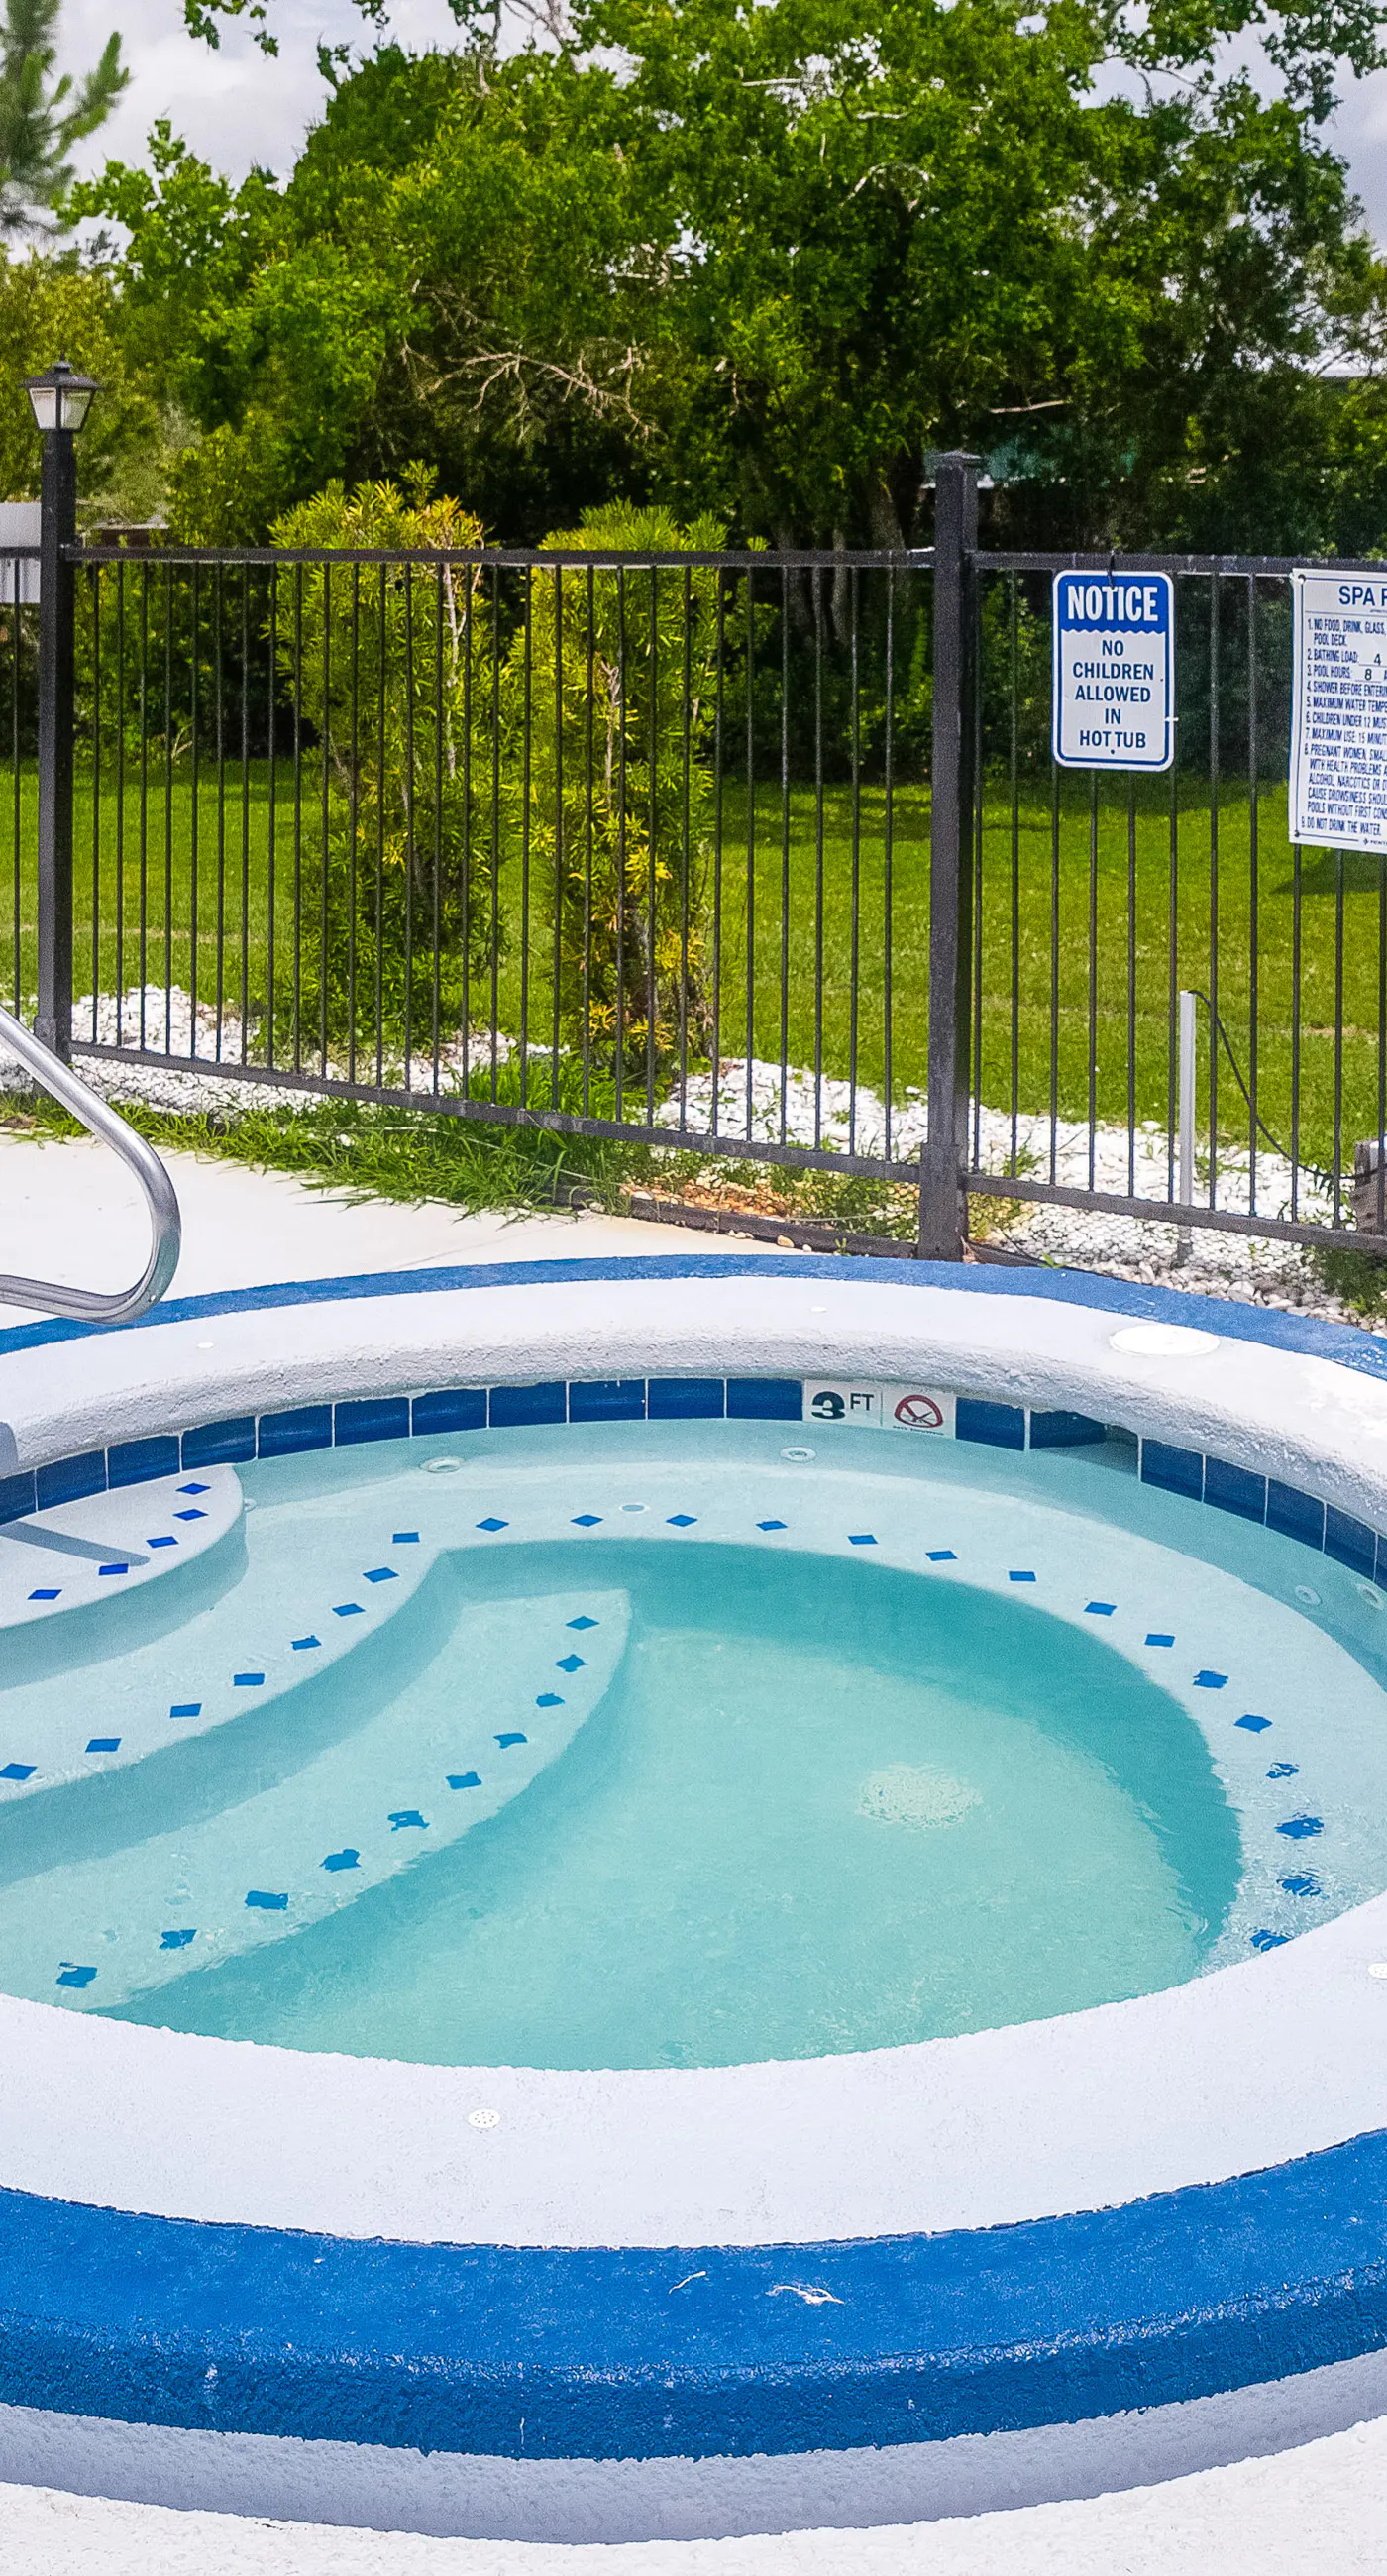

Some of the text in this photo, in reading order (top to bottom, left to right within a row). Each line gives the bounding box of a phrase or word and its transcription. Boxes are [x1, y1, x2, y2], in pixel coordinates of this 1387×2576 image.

[1067, 585, 1159, 621] NOTICE
[1338, 585, 1376, 606] SPA
[1314, 618, 1323, 630] NO
[1314, 633, 1329, 645] POOL
[1102, 640, 1123, 656] NO
[1308, 648, 1313, 660] 2.
[1314, 649, 1339, 662] BATHING
[1374, 653, 1381, 666] 4
[1073, 662, 1154, 680] CHILDREN
[1314, 664, 1329, 677] POOL
[1364, 668, 1372, 680] 8
[1075, 685, 1151, 702] ALLOWED
[1314, 681, 1338, 694] SHOWER
[1340, 682, 1362, 696] BEFORE
[1313, 697, 1343, 709] MAXIMUM
[1345, 698, 1366, 711] WATER
[1105, 708, 1120, 724] IN
[1313, 711, 1340, 725] CHILDREN
[1342, 713, 1362, 727] UNDER
[1080, 730, 1146, 748] HOT TUB
[1312, 727, 1342, 741] MAXIMUM
[1311, 743, 1341, 757] PREGNANT
[1310, 758, 1325, 770] WITH
[1327, 759, 1348, 772] HEALTH
[1350, 761, 1382, 776] PROBLEMS
[1337, 775, 1370, 789] NARCOTICS
[1308, 787, 1326, 800] CAUSE
[1329, 788, 1366, 804] DROWSINESS
[1308, 801, 1325, 813] POOLS
[1328, 803, 1353, 816] WITHOUT
[1354, 805, 1371, 818] FIRST
[1308, 816, 1315, 828] DO
[1316, 817, 1327, 830] NOT
[1329, 818, 1344, 831] DRINK
[1347, 820, 1357, 833] THE
[811, 1391, 874, 1420] 3 FT
